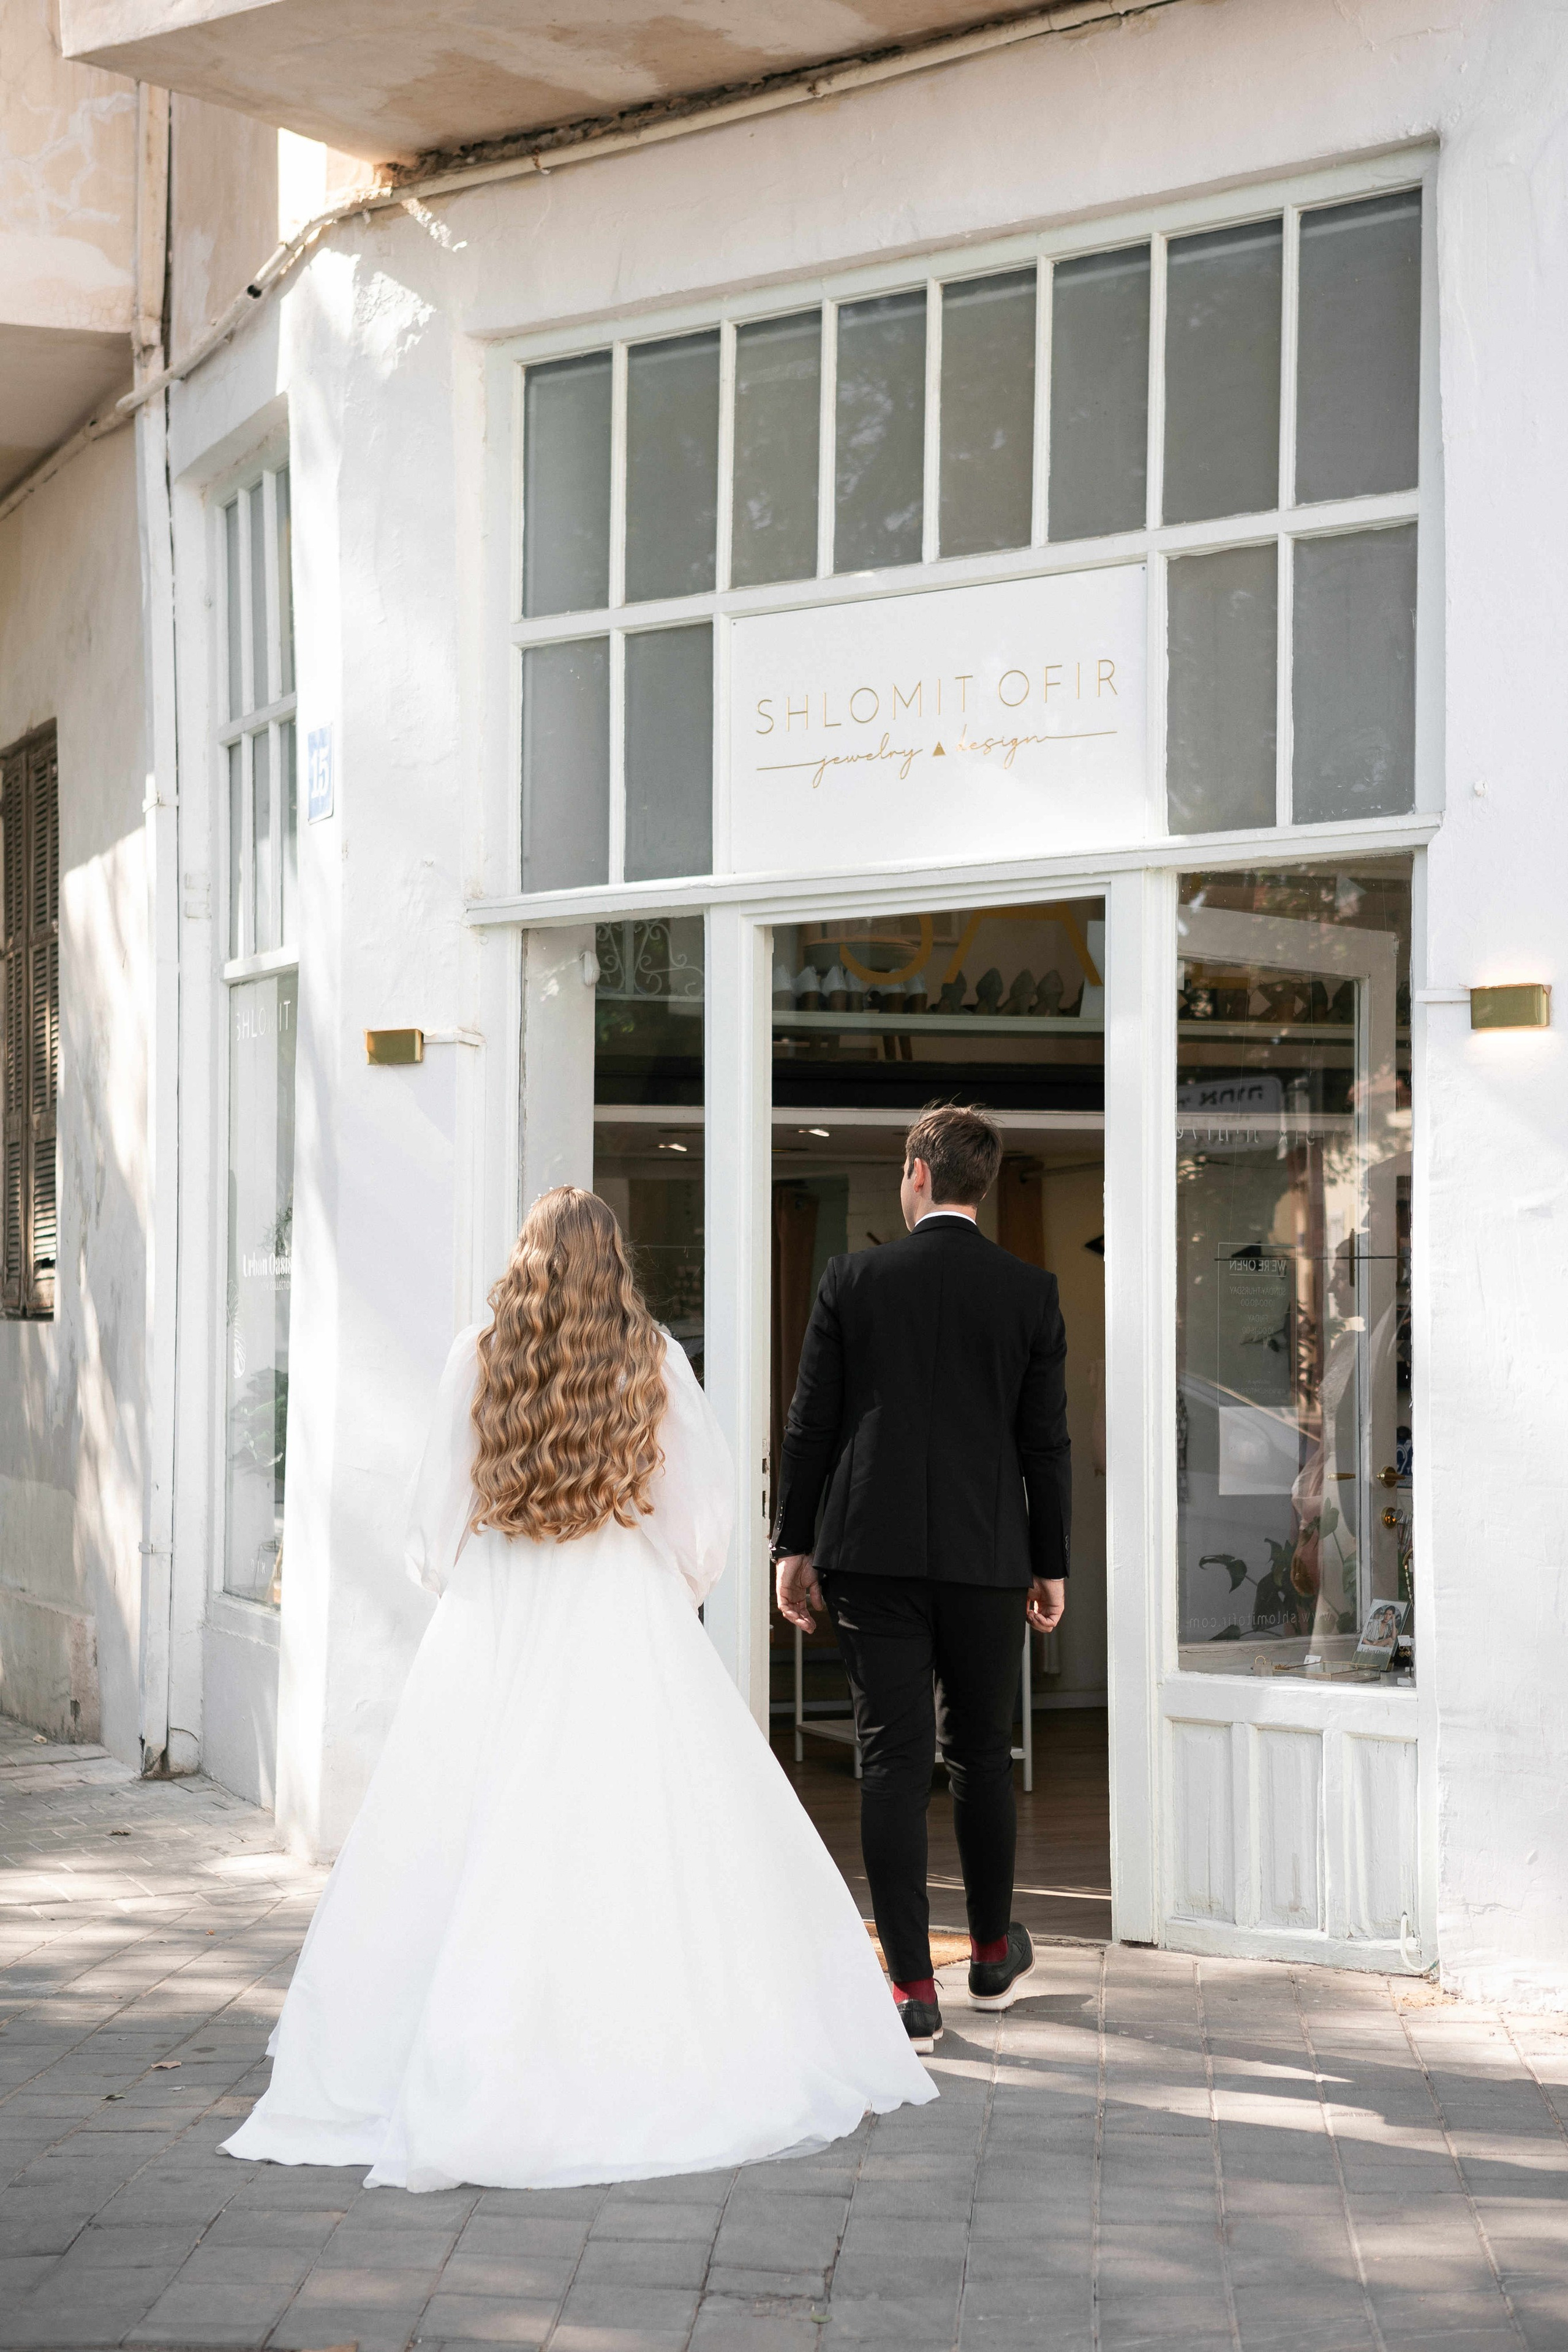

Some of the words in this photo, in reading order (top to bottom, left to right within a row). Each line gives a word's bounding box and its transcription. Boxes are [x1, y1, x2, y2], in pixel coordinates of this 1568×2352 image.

[756, 674, 973, 734] SHLOMIT
[998, 659, 1118, 707] OFIR
[311, 745, 330, 799] 15
[812, 732, 923, 788] jewelry
[955, 724, 1050, 769] design
[243, 1252, 268, 1277] Urban
